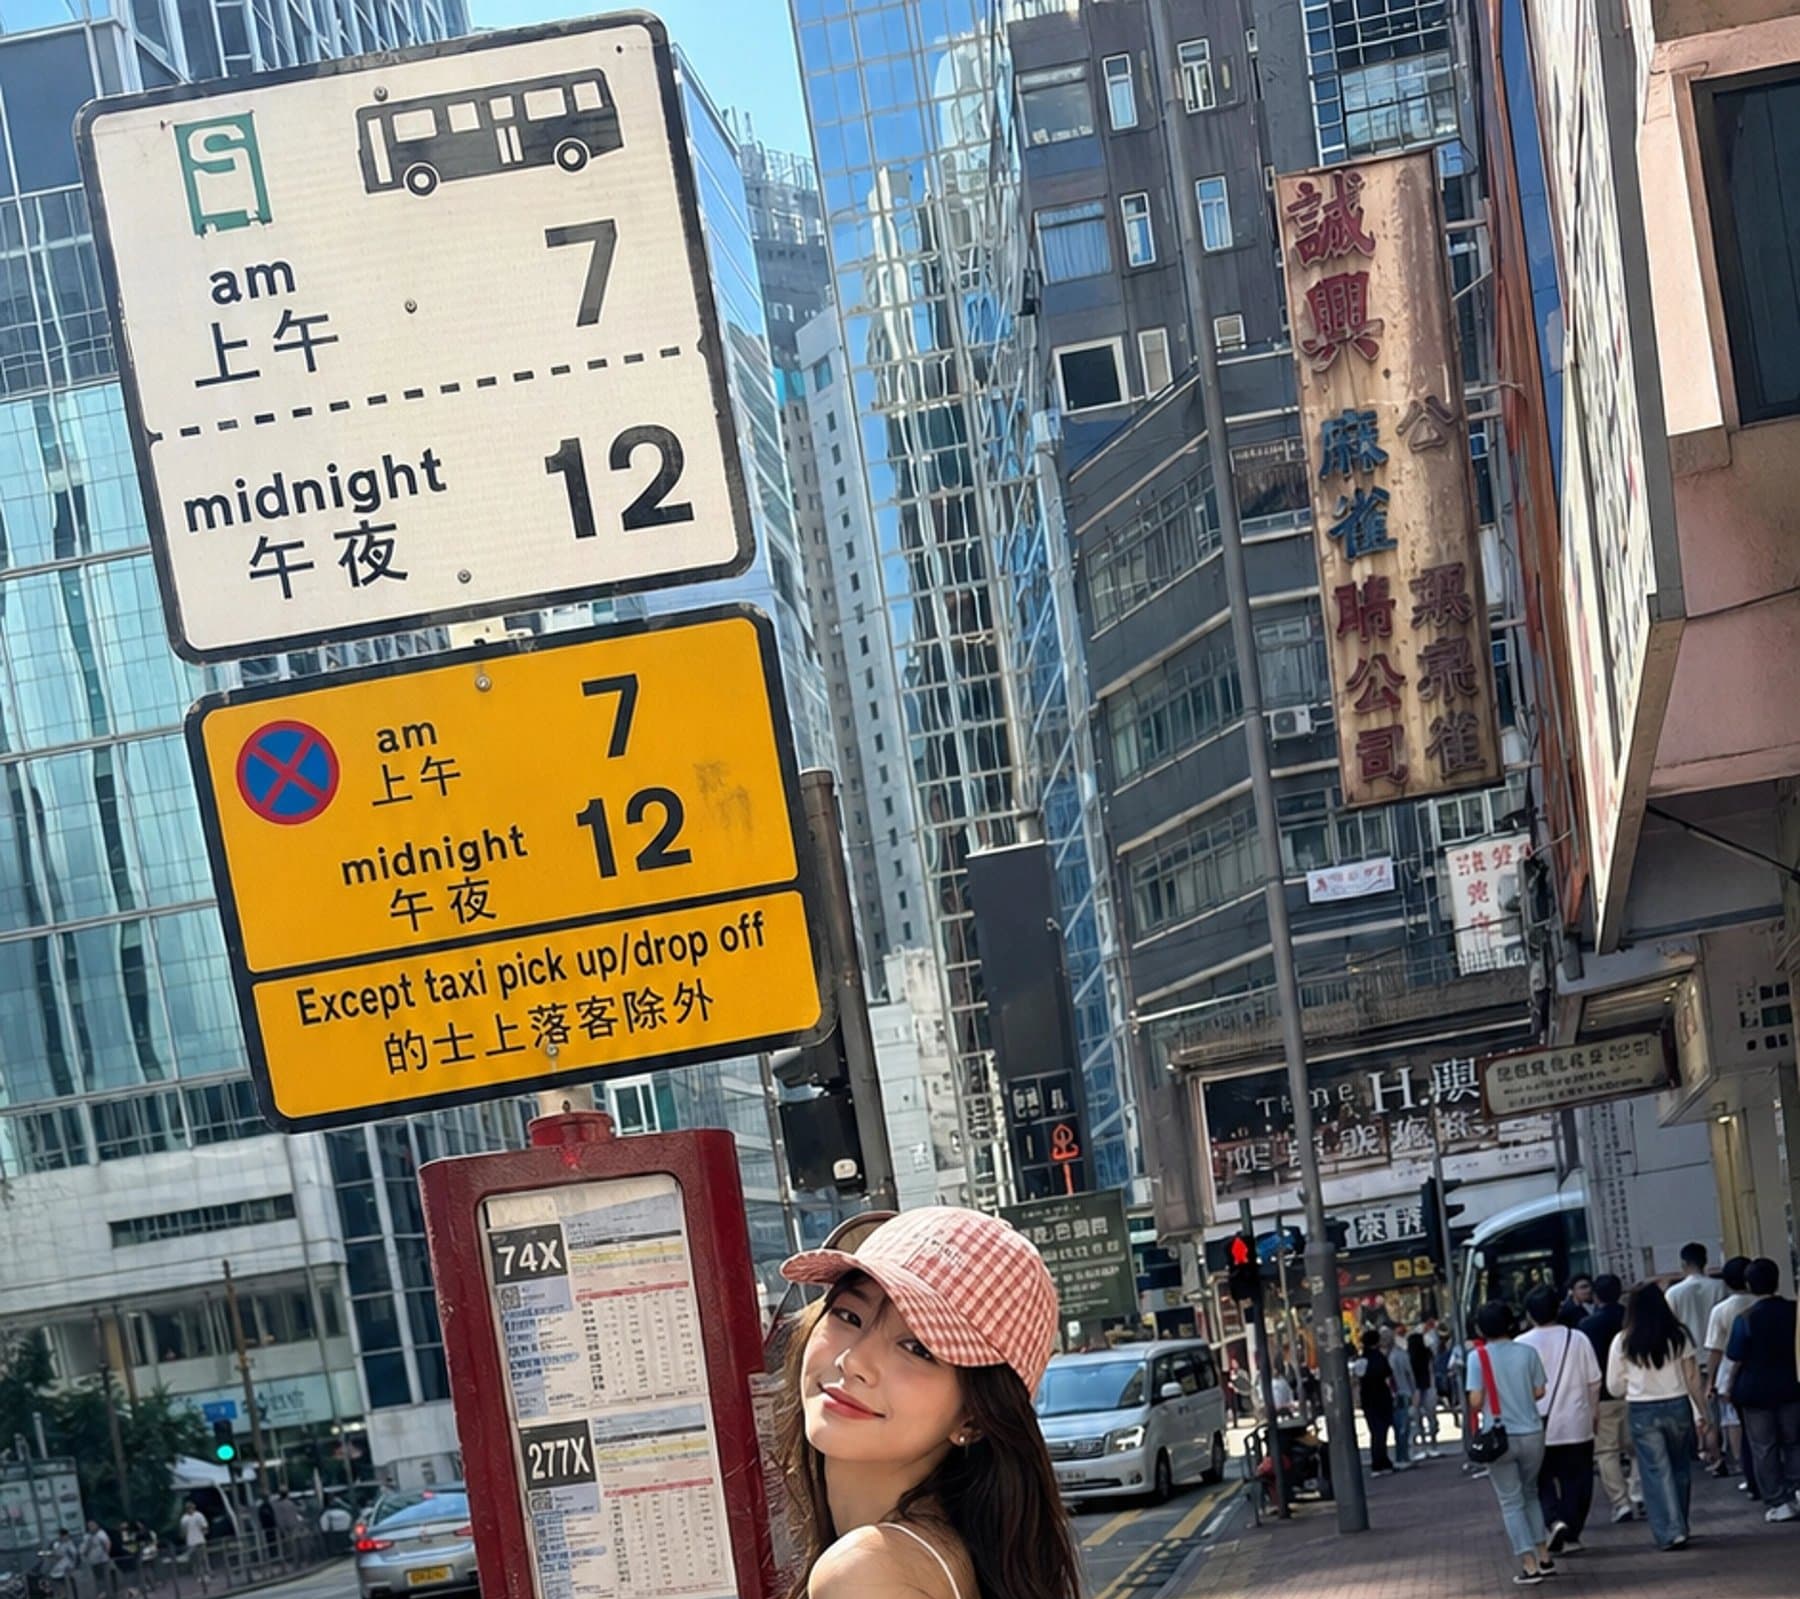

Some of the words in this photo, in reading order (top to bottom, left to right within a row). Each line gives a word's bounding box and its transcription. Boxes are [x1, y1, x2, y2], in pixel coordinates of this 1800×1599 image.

[208, 260, 296, 306] am
[543, 218, 618, 328] 7
[193, 308, 340, 389] 上午
[182, 447, 449, 534] midnight
[543, 423, 696, 541] 12
[248, 519, 409, 601] 午夜
[375, 721, 438, 755] am
[580, 672, 640, 760] 7
[371, 755, 462, 808] 上午
[340, 824, 529, 887] midnight
[574, 786, 694, 880] 12
[389, 877, 498, 933] 午夜
[296, 973, 416, 1026] Except
[424, 958, 487, 1004] taxi
[497, 946, 568, 1001] pick
[577, 930, 709, 980] up/drop
[719, 910, 765, 953] off
[383, 978, 714, 1073] 的士上落客除外
[496, 1239, 563, 1277] 74X
[527, 1436, 591, 1481] 277X
